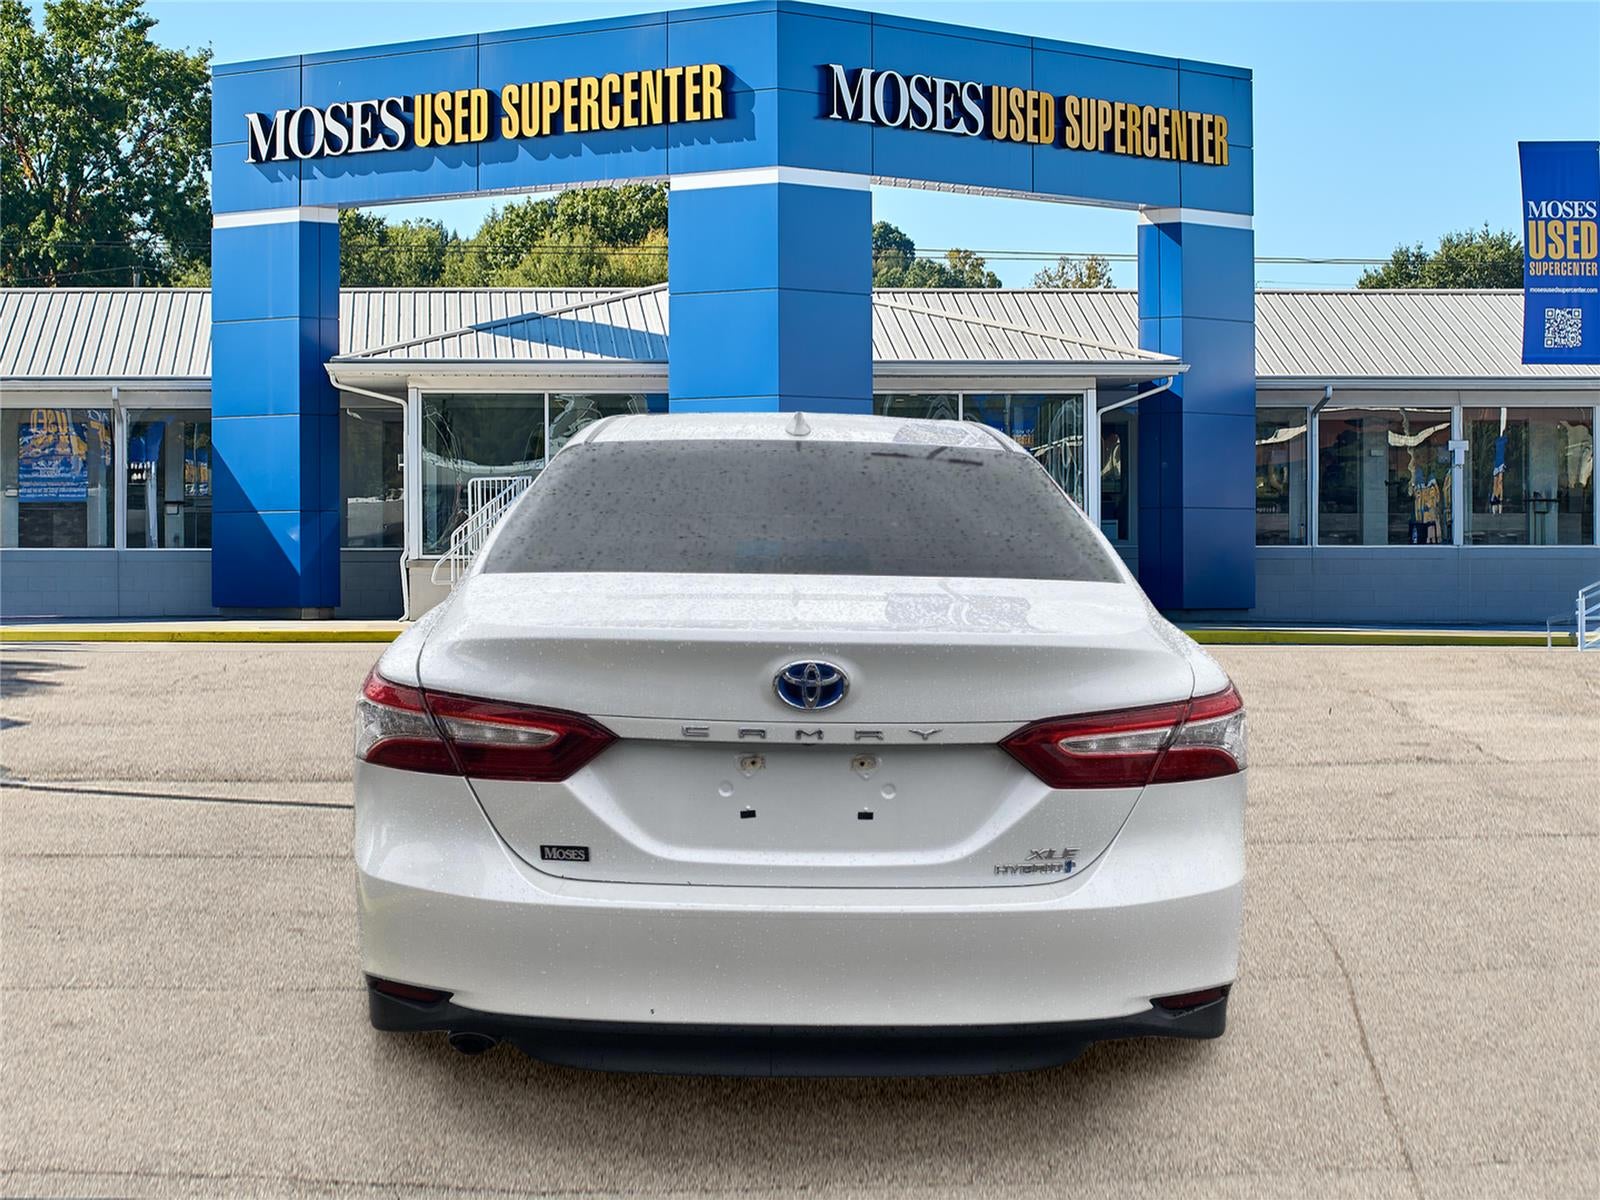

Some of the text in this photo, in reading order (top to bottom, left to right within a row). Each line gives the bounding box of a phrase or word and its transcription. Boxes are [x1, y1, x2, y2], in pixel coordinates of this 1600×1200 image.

[244, 63, 723, 164] MOSES USED SUPERCENTER
[829, 63, 1229, 165] MOSES USED SUPERCENTER
[1528, 200, 1598, 219] MOSES
[1528, 220, 1598, 260] USED
[1529, 261, 1598, 276] SUPERCENTER
[681, 726, 943, 741] CAMRY
[544, 846, 586, 860] MOSES
[1024, 848, 1080, 860] XLE
